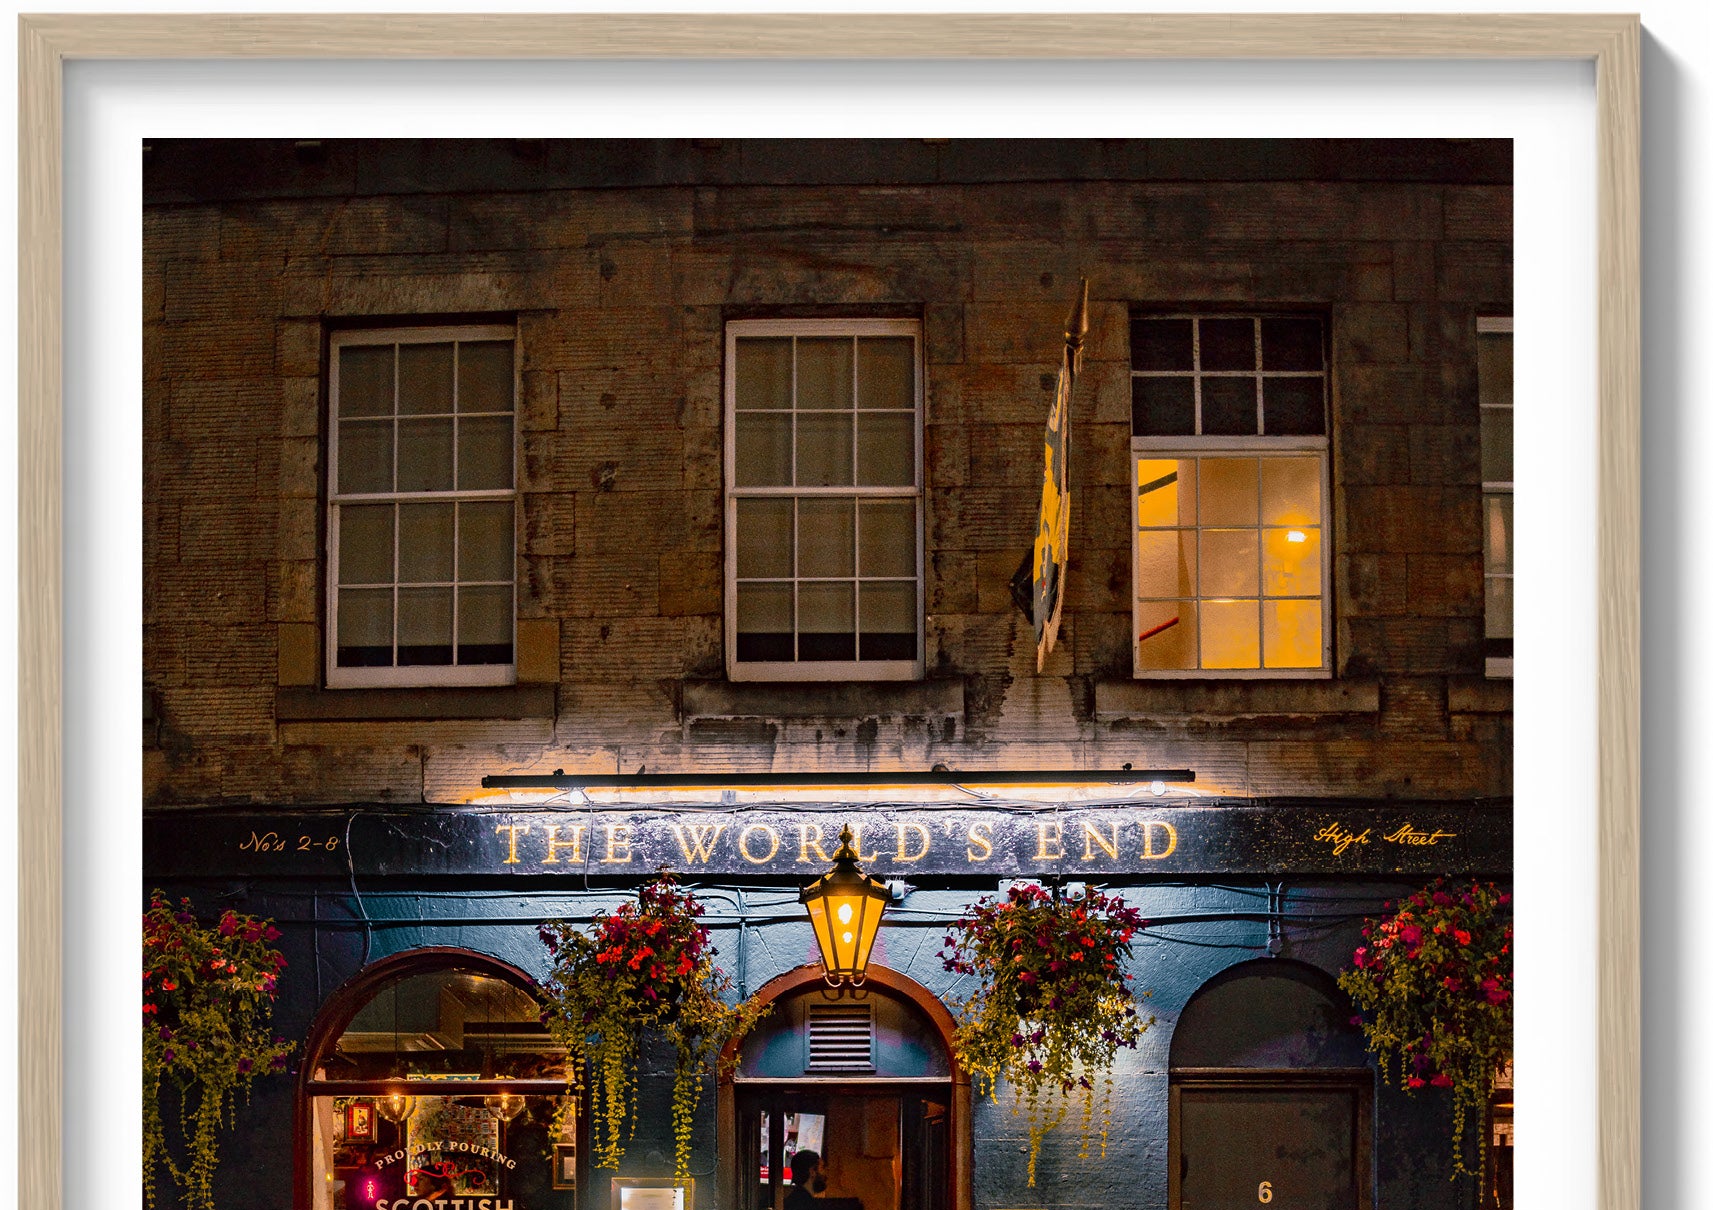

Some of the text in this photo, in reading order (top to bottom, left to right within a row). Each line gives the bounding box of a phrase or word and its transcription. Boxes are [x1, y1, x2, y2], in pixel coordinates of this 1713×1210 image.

[239, 831, 340, 853] No's 2-8
[495, 820, 1178, 865] THE WORLD'S END
[1313, 821, 1457, 856] High Street
[374, 1141, 517, 1170] PROUDLY POURING
[1258, 1181, 1273, 1204] 6
